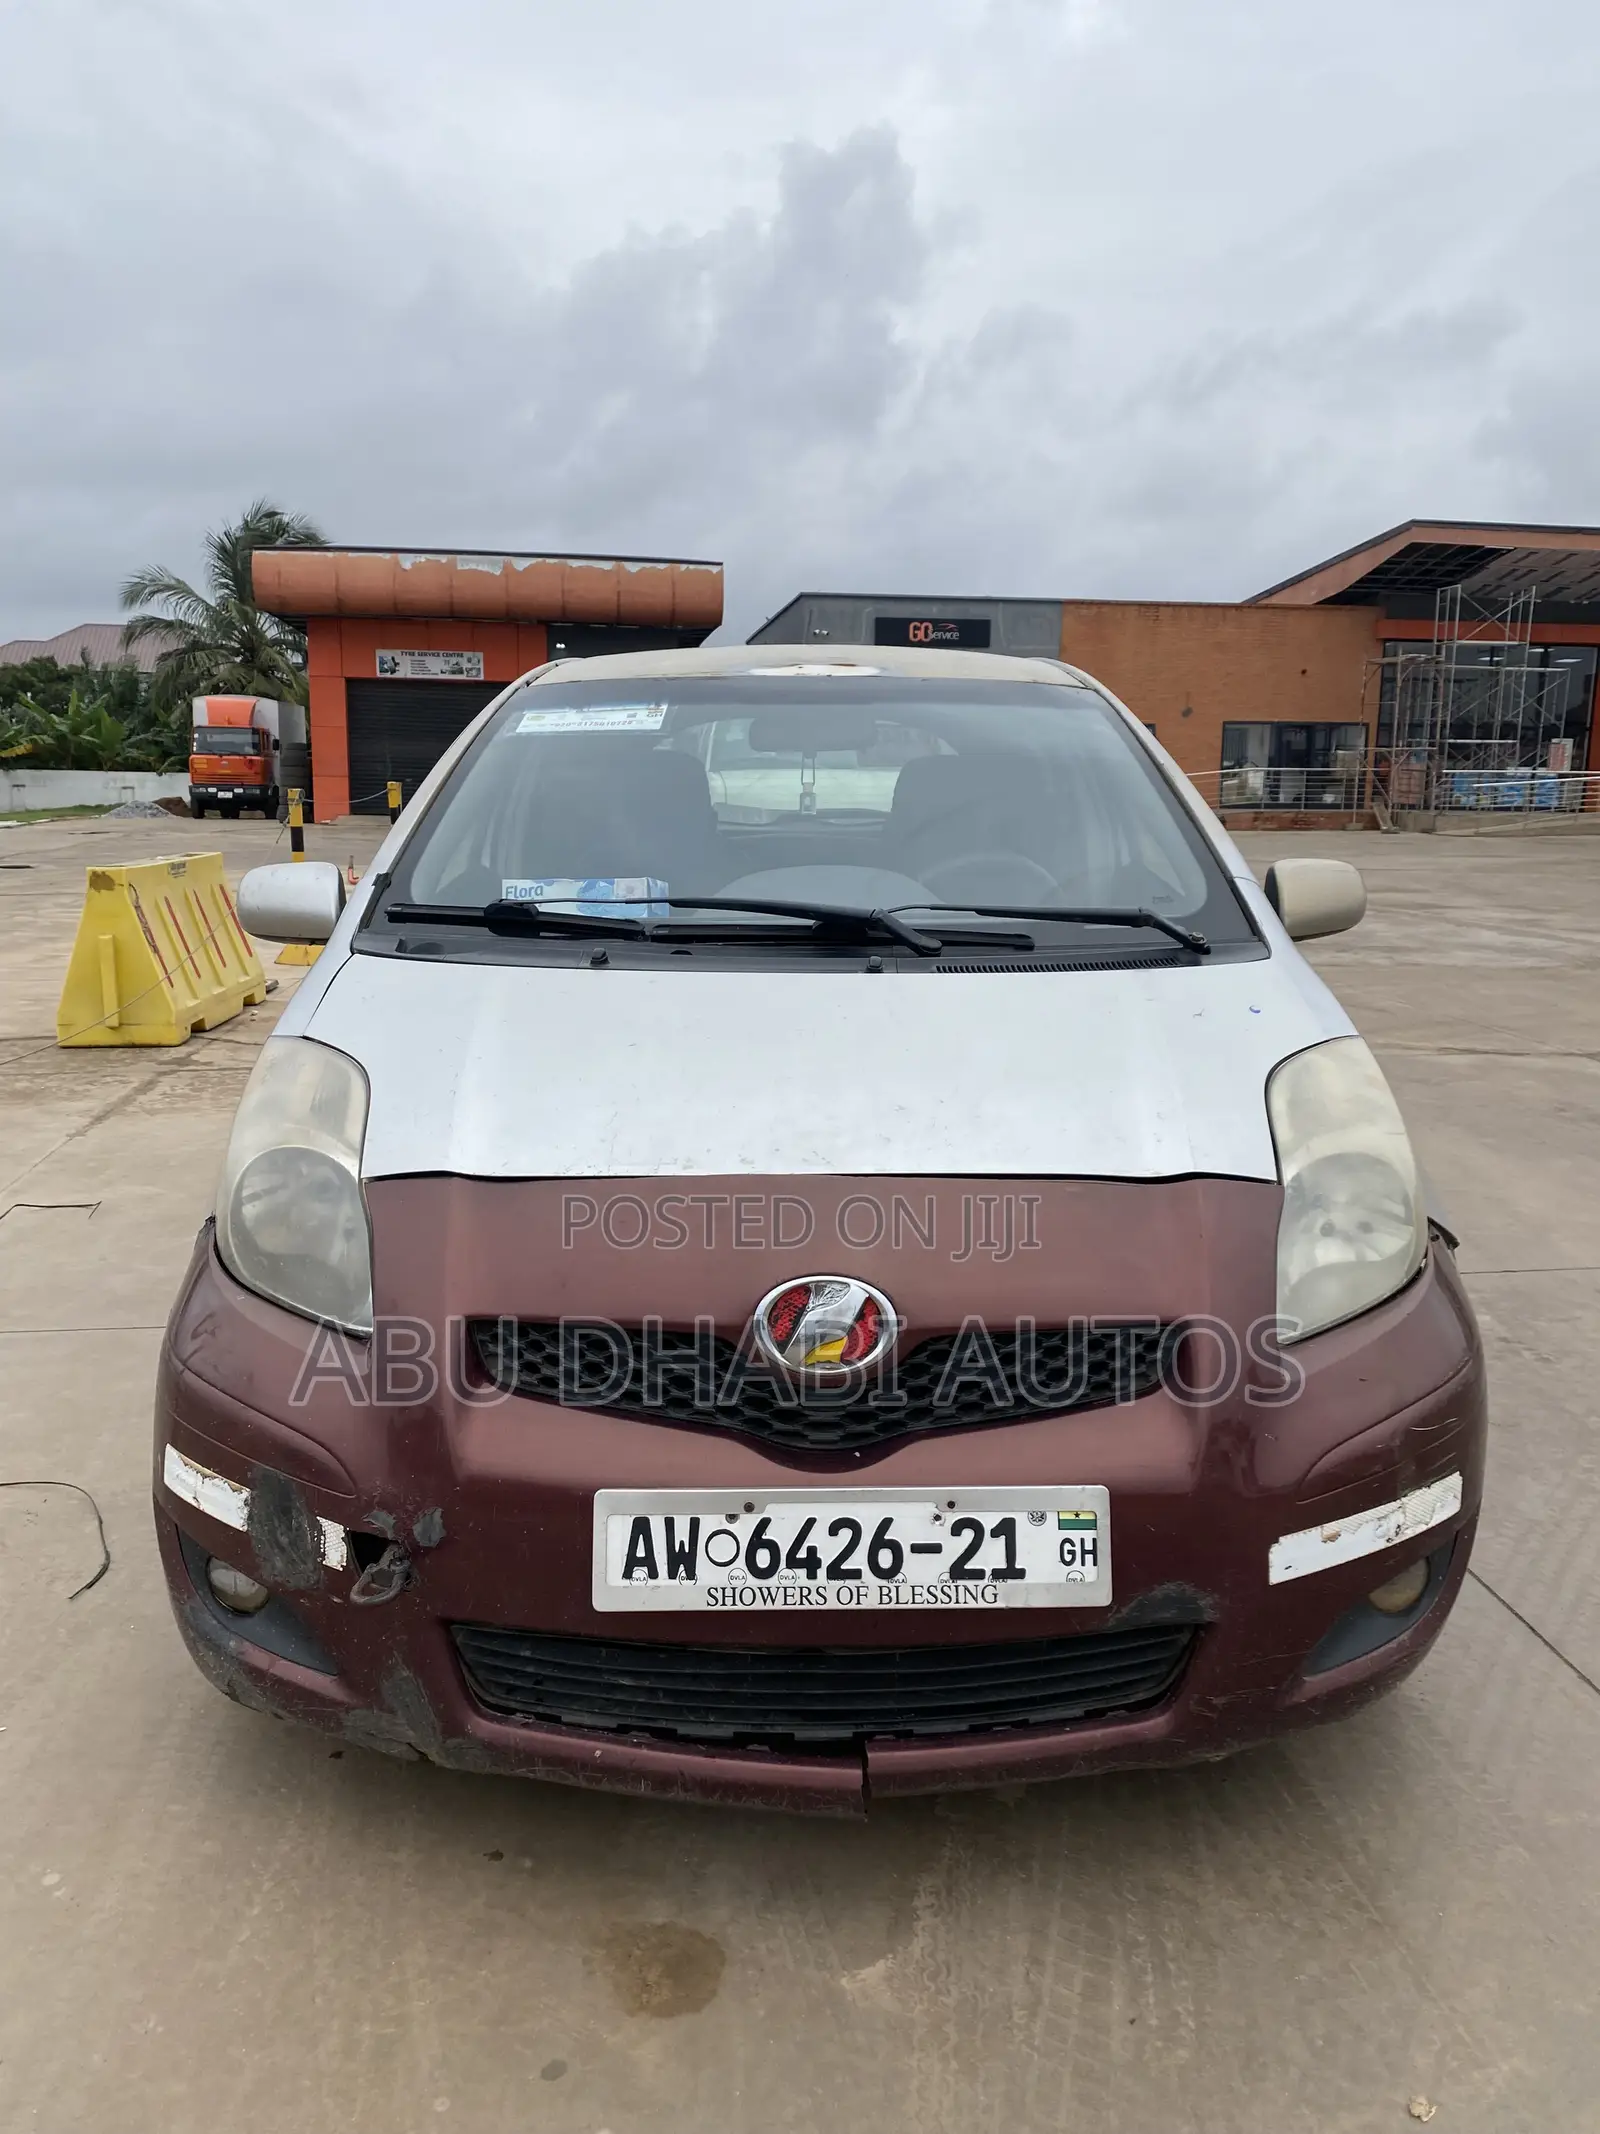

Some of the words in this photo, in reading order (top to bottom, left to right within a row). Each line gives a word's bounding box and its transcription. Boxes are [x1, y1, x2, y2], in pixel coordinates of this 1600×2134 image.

[506, 885, 544, 899] Flora
[622, 1516, 700, 1580] AW
[745, 1516, 1026, 1580] 6426-21
[1059, 1537, 1098, 1567] GH
[706, 1586, 827, 1607] SHOWERS
[836, 1585, 870, 1606] OF
[878, 1584, 999, 1605] BLESSING
